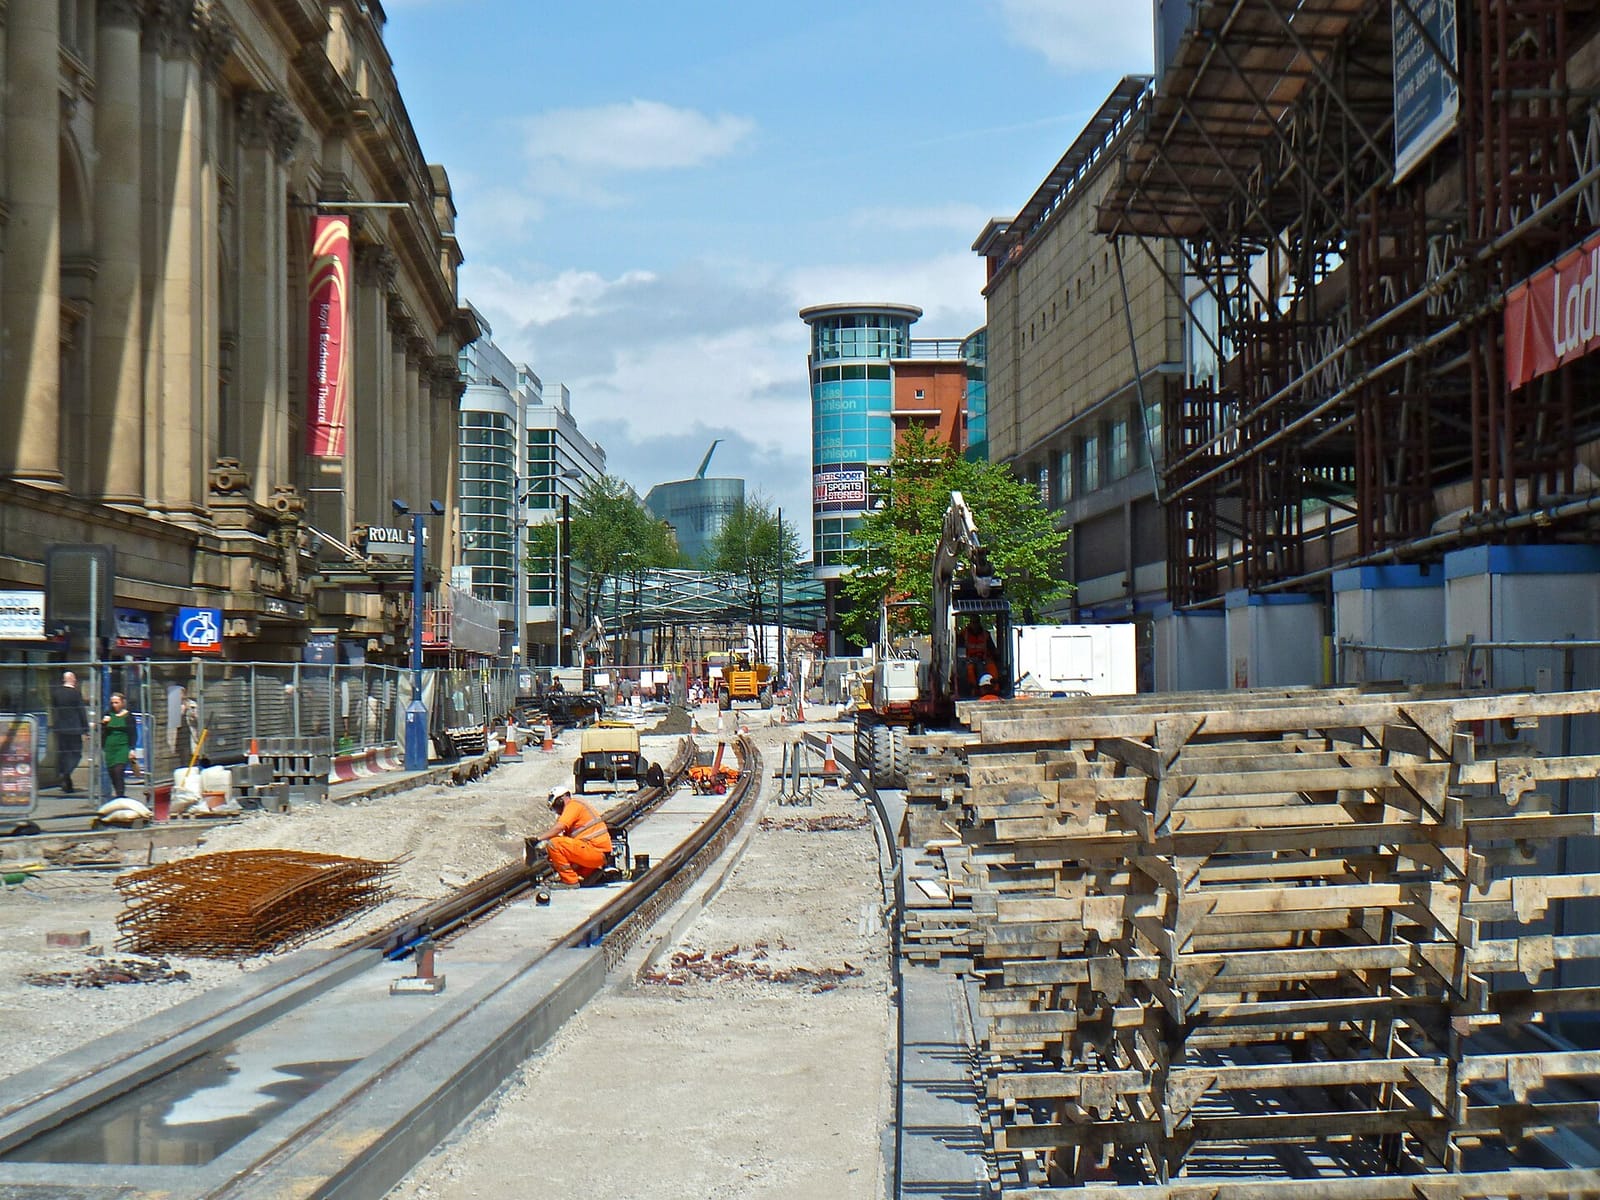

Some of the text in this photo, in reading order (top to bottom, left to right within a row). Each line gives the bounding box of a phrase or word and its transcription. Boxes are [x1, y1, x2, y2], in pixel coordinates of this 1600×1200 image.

[318, 303, 329, 329] Royal
[317, 333, 329, 384] Exchange
[828, 482, 862, 492] SPORTS
[828, 491, 862, 500] STORES
[369, 527, 405, 543] ROYAL
